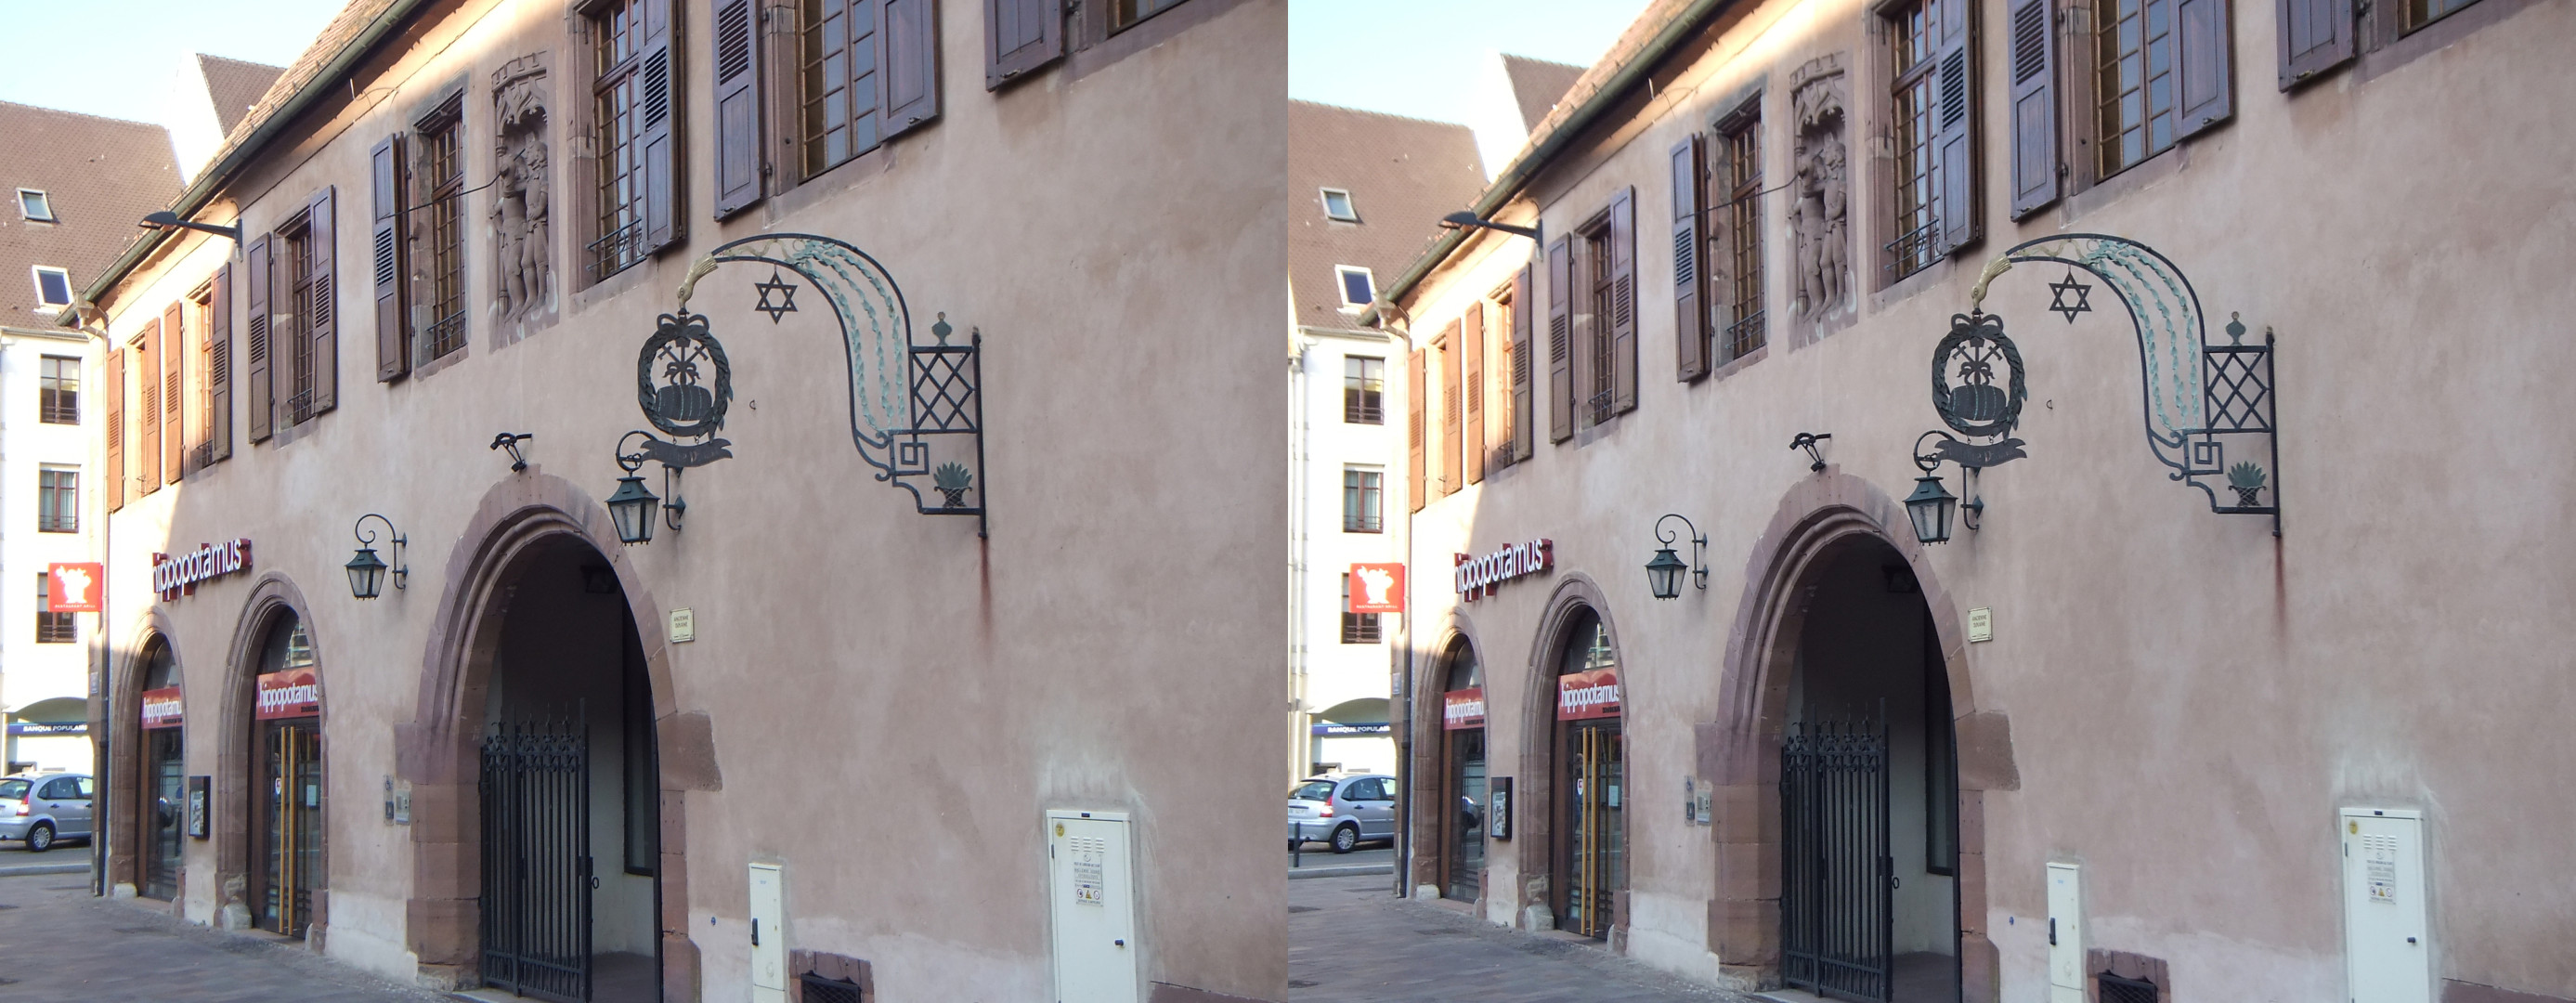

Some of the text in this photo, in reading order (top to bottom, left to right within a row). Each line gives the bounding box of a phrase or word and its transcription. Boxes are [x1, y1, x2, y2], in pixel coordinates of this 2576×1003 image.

[151, 538, 244, 602] hippopotamus
[1453, 538, 1545, 602] hippopotamus
[143, 697, 183, 723] hippopotamu
[1446, 697, 1485, 724] hippopotamu
